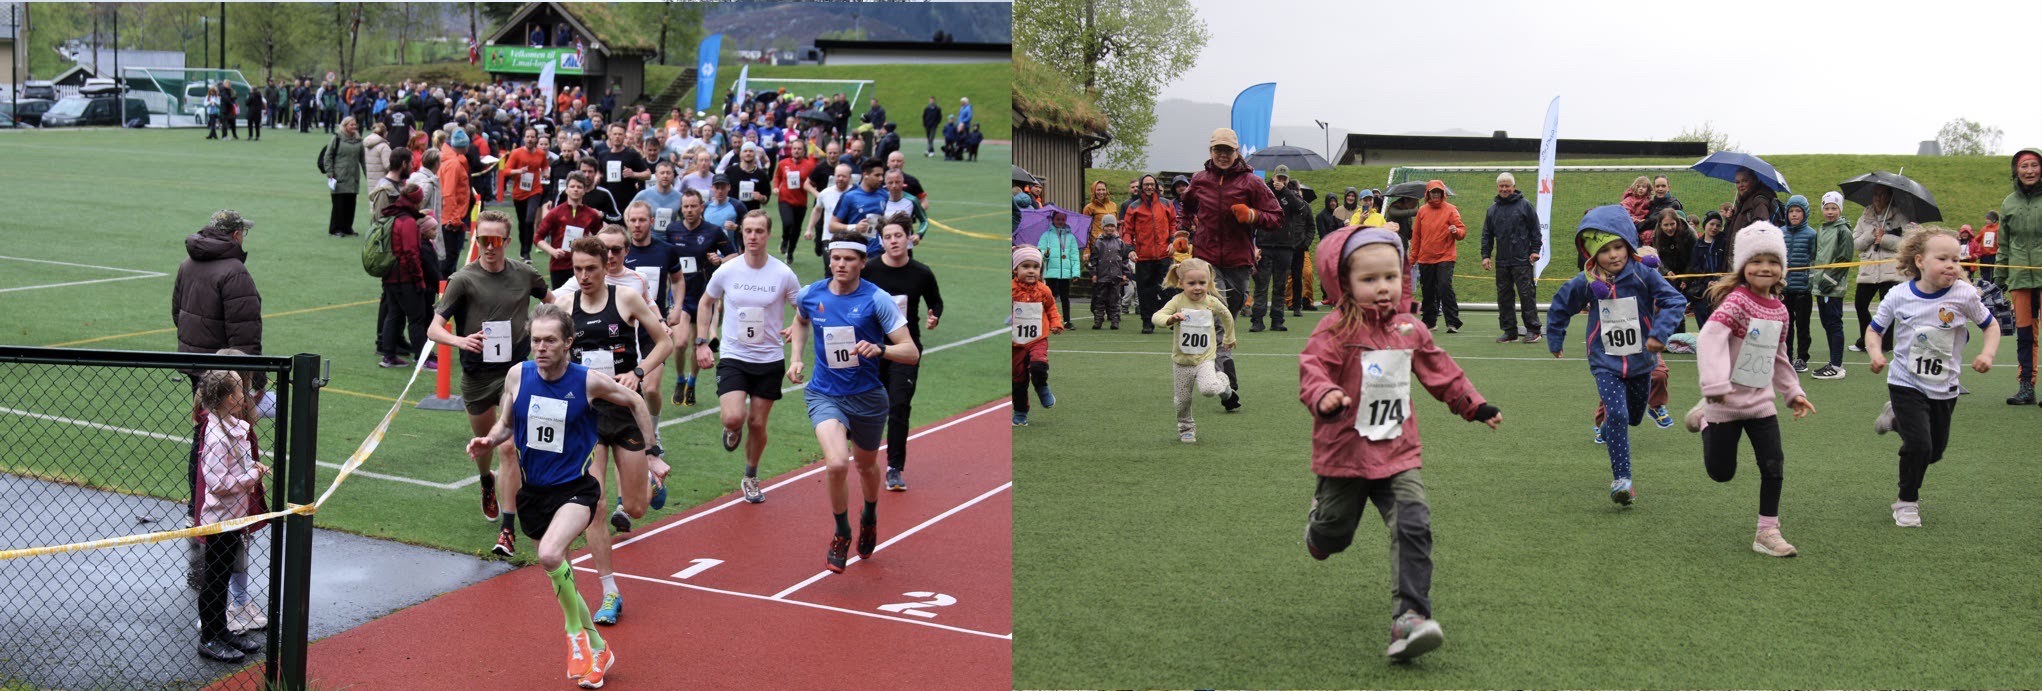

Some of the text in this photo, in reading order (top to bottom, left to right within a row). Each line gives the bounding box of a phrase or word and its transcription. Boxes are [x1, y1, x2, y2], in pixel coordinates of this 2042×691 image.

[510, 48, 546, 59] Velkomen
[659, 219, 667, 228] 12
[683, 259, 689, 269] 7
[747, 326, 755, 338] 5
[1017, 324, 1038, 338] 118
[1605, 328, 1637, 347] 190
[1181, 332, 1208, 348] 200
[494, 343, 501, 356] 1
[833, 349, 850, 362] 10
[1915, 355, 1943, 376] 116
[1369, 398, 1404, 426] 174
[536, 425, 555, 444] 19
[670, 557, 726, 580] 1
[876, 591, 958, 619] 2
